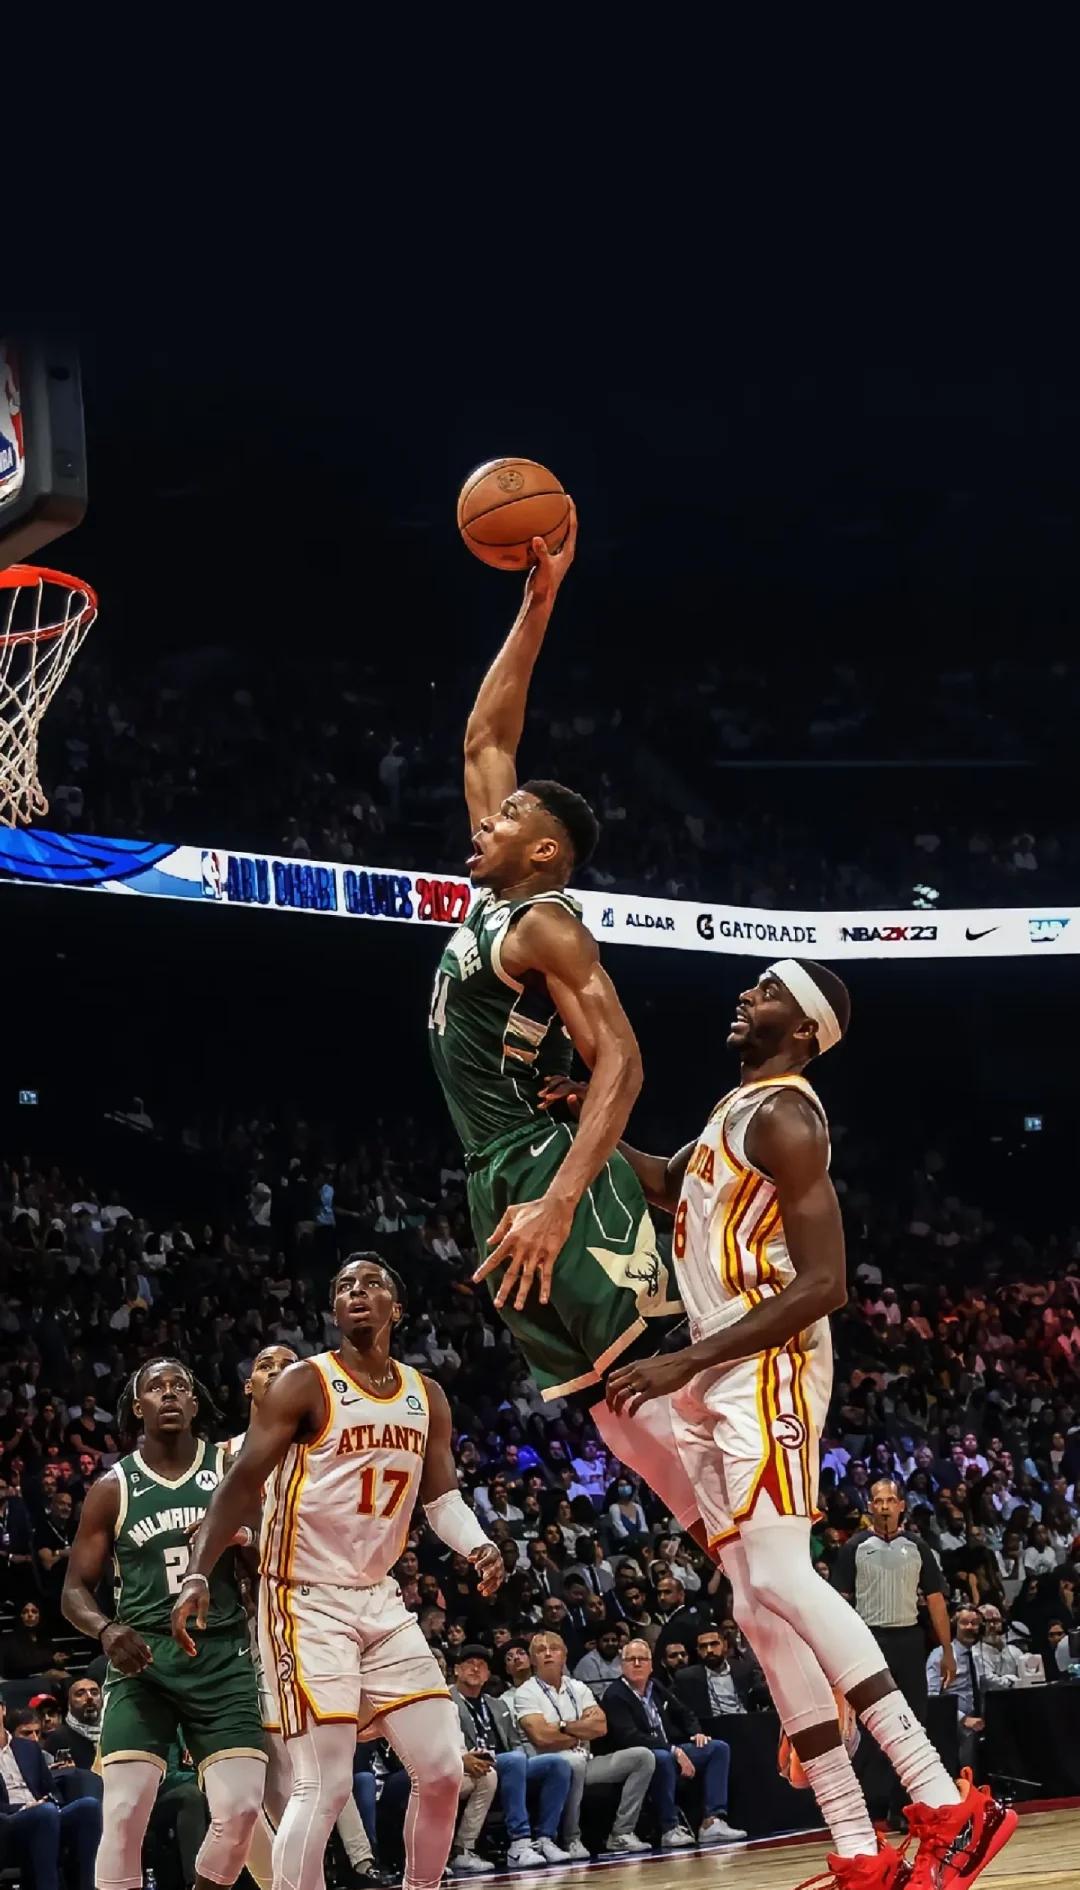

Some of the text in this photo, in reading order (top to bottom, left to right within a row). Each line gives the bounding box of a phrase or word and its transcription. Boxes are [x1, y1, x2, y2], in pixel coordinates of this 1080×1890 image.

[626, 913, 675, 931] ALDAR
[719, 920, 817, 943] GATORADE
[357, 1466, 411, 1519] 17
